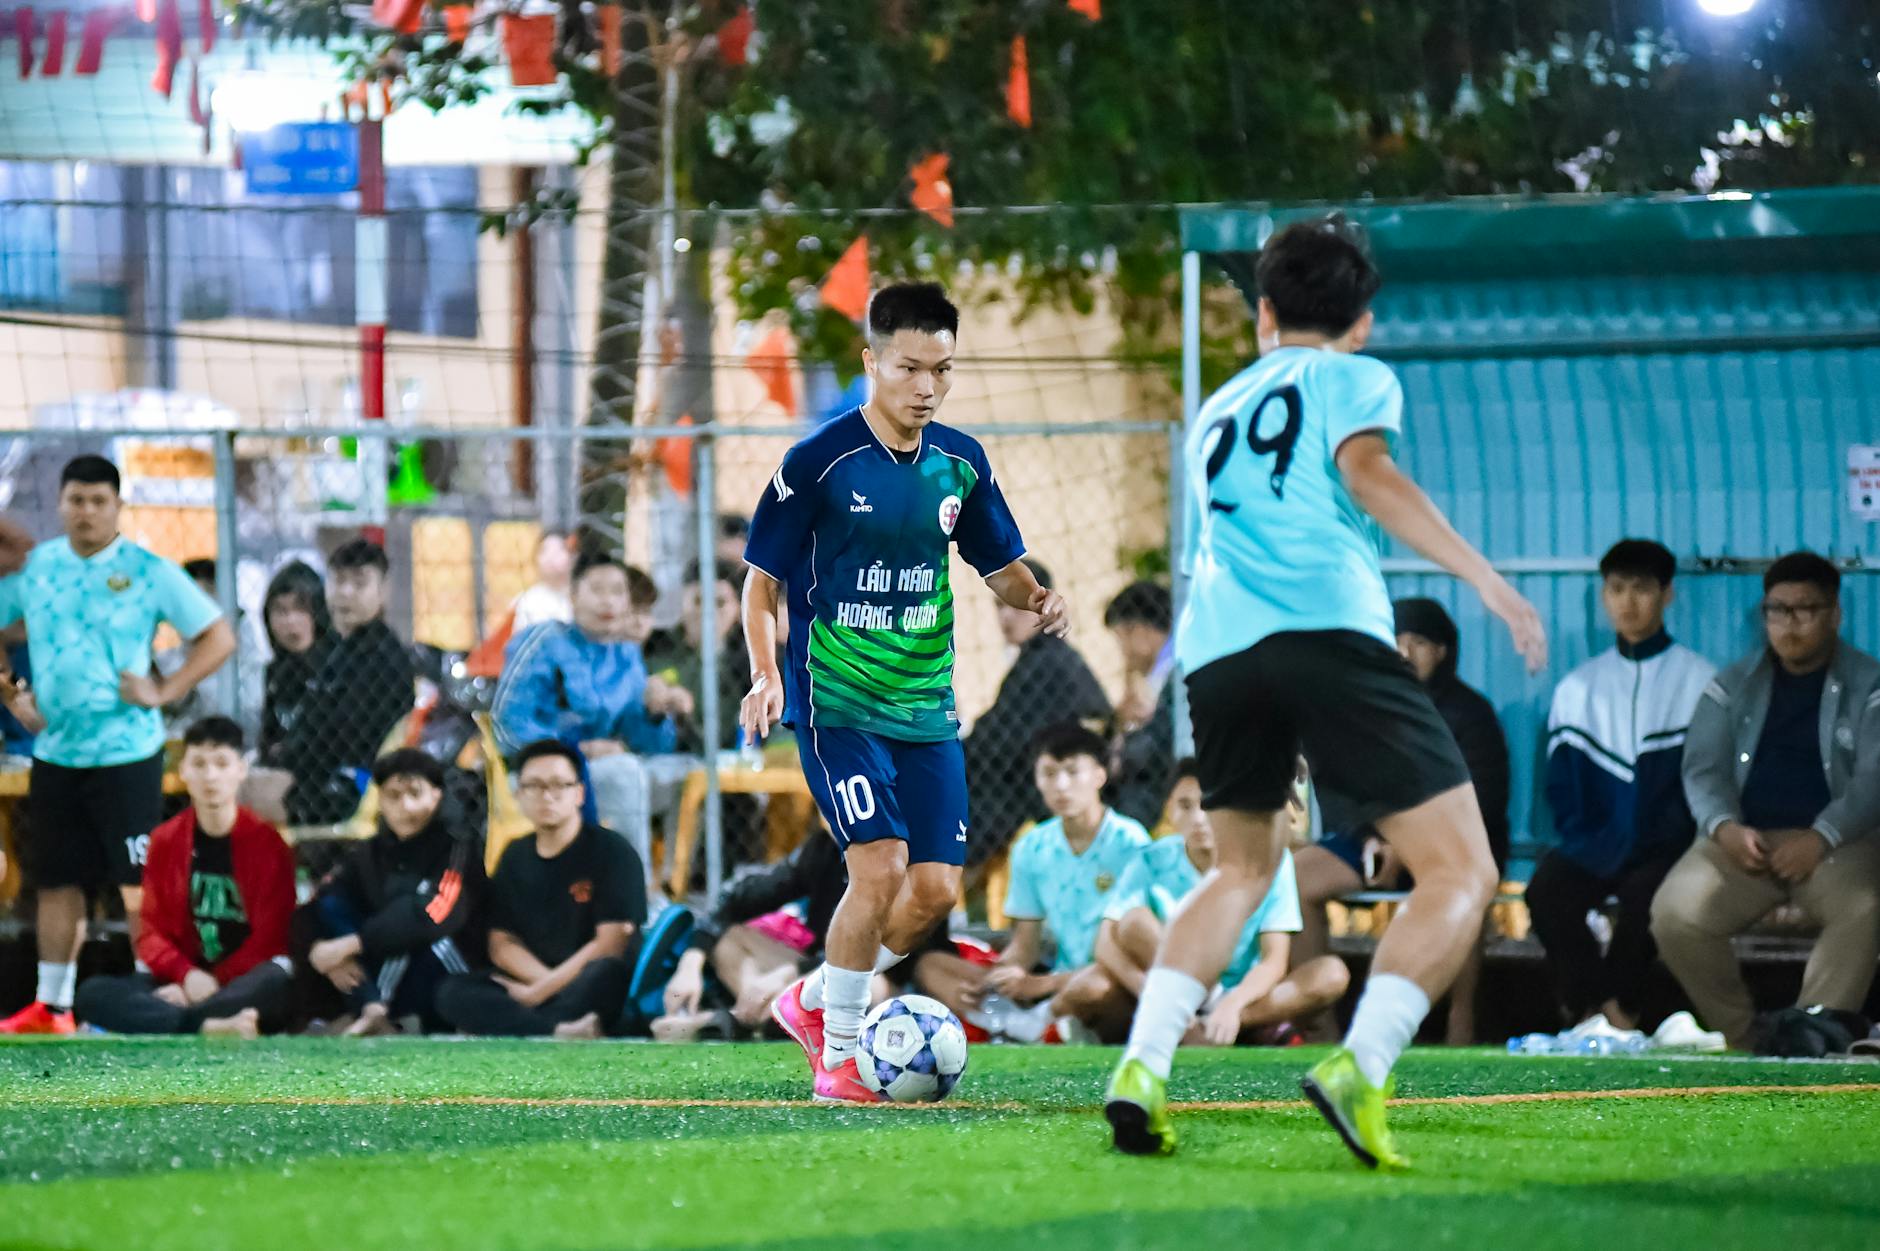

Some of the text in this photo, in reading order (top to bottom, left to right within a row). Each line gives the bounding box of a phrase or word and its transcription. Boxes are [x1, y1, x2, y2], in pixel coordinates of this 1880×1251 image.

[1200, 384, 1304, 514] 29
[857, 560, 934, 592] LẨU NẤM
[836, 600, 893, 630] HOÀNG
[835, 774, 876, 825] 10
